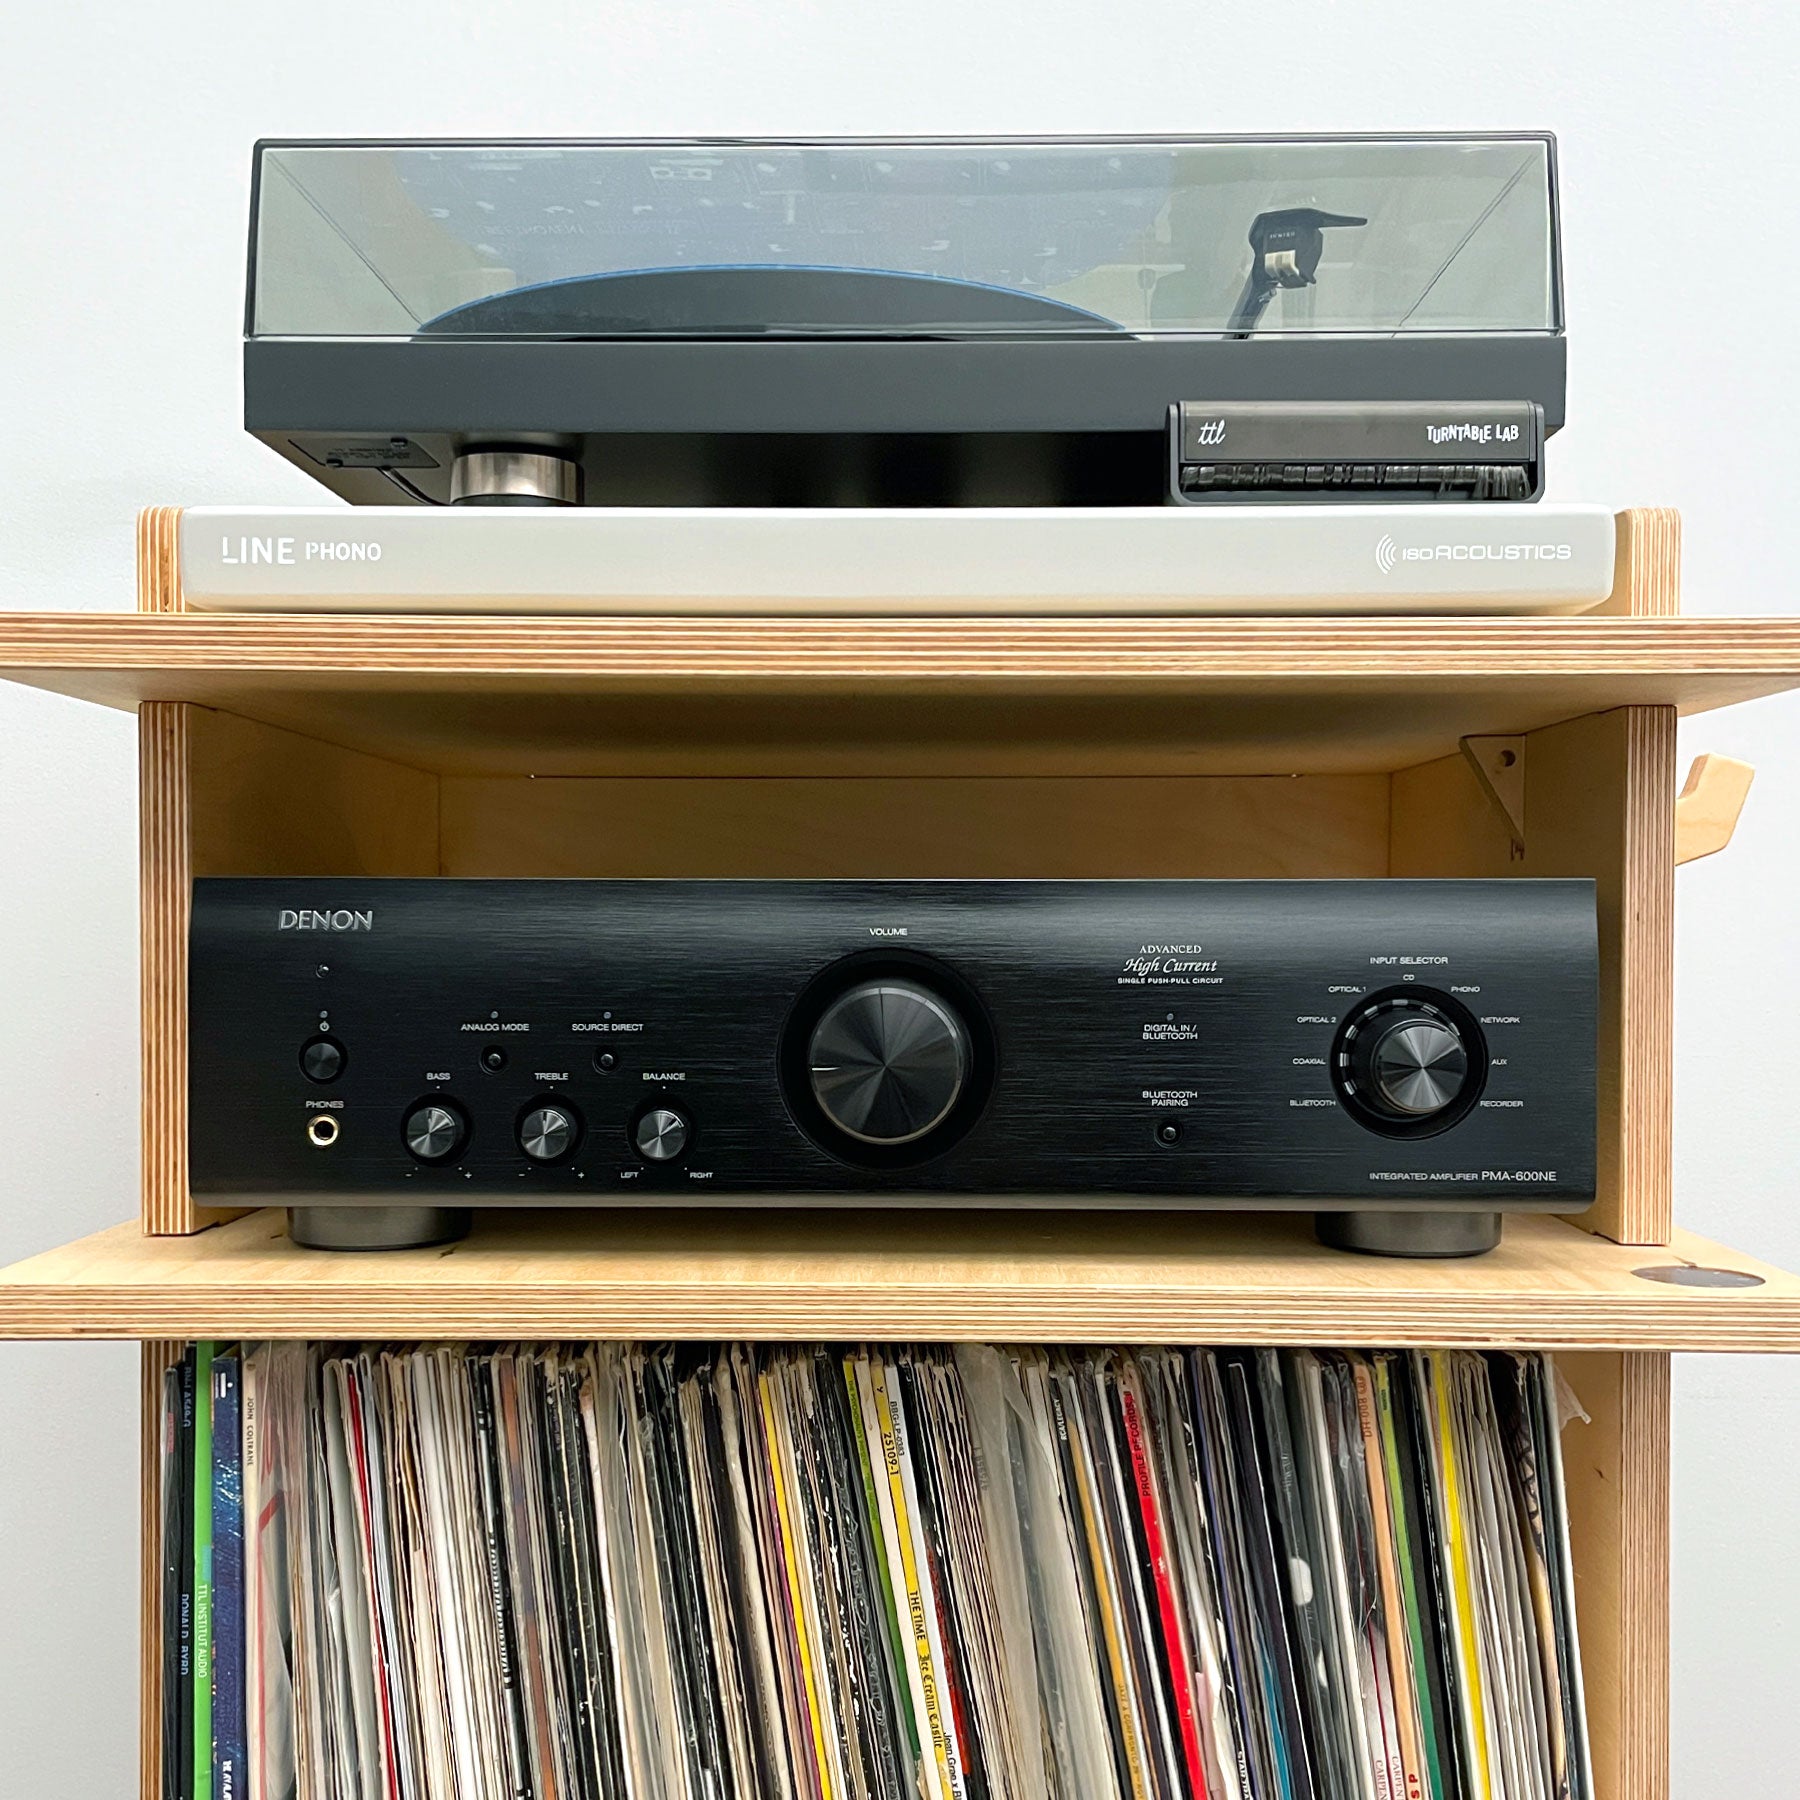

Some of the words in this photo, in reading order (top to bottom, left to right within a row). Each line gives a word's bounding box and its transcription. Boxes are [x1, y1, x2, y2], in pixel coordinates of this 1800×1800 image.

[1197, 419, 1226, 445] ttl
[1426, 424, 1492, 445] TURNTABLE
[1495, 423, 1519, 441] LAB
[222, 536, 296, 565] LINE
[305, 542, 382, 561] PHONO
[278, 909, 374, 932] DENON
[869, 927, 908, 936] VOLUME
[1139, 945, 1202, 954] ADVANCED
[1370, 956, 1397, 965] INPUT
[1399, 956, 1449, 965] SELECTOR
[1122, 957, 1159, 977] High
[1162, 957, 1218, 974] Current
[1117, 977, 1146, 985] SINGLE
[1147, 977, 1191, 985] PUSH-PULL
[1191, 977, 1224, 985] CIRCUIT
[1296, 1016, 1330, 1024] OPTICAL
[1480, 1016, 1521, 1024] NETWORK
[461, 1023, 500, 1032] ANALOG
[501, 1023, 530, 1032] MODE
[571, 1023, 610, 1032] SOURCE
[611, 1023, 644, 1032] DIRECT
[1143, 1024, 1179, 1032] DIGITAL
[1180, 1024, 1191, 1032] IN
[1142, 1032, 1198, 1040] BLUETOOTH
[1292, 1057, 1326, 1065] COAXIAL
[1491, 1058, 1508, 1066] AUX
[426, 1072, 451, 1081] BASS
[534, 1072, 569, 1081] TREBLE
[642, 1072, 686, 1081] BALANCE
[1142, 1090, 1198, 1099] BLUETOOTH
[305, 1100, 345, 1109] PHONES
[1151, 1098, 1189, 1107] PAIRING
[1289, 1099, 1337, 1107] BLUETOOTH
[1479, 1100, 1524, 1108] RECORDER
[620, 1171, 639, 1179] LEFT
[689, 1171, 714, 1179] RIGHT
[1369, 1172, 1429, 1181] INTEGRATED
[1429, 1172, 1478, 1181] AMPLIFIER
[1480, 1171, 1557, 1181] PMA-600NE
[246, 1397, 255, 1420] JOHN
[246, 1425, 255, 1467] COLTRANE
[883, 1431, 899, 1476] 25109-1
[1135, 1454, 1151, 1497] PROFILE
[198, 1584, 208, 1601] TTL
[909, 1590, 921, 1613] THE
[197, 1603, 208, 1646] INSTITUT
[912, 1614, 926, 1641] TIME
[197, 1648, 207, 1678] AUDIO
[919, 1654, 932, 1671] Ice
[923, 1674, 937, 1710] Cream
[929, 1713, 944, 1748] Castle
[943, 1732, 954, 1755] Jean
[947, 1757, 958, 1781] Grae
[1391, 1756, 1404, 1800] CARPEN
